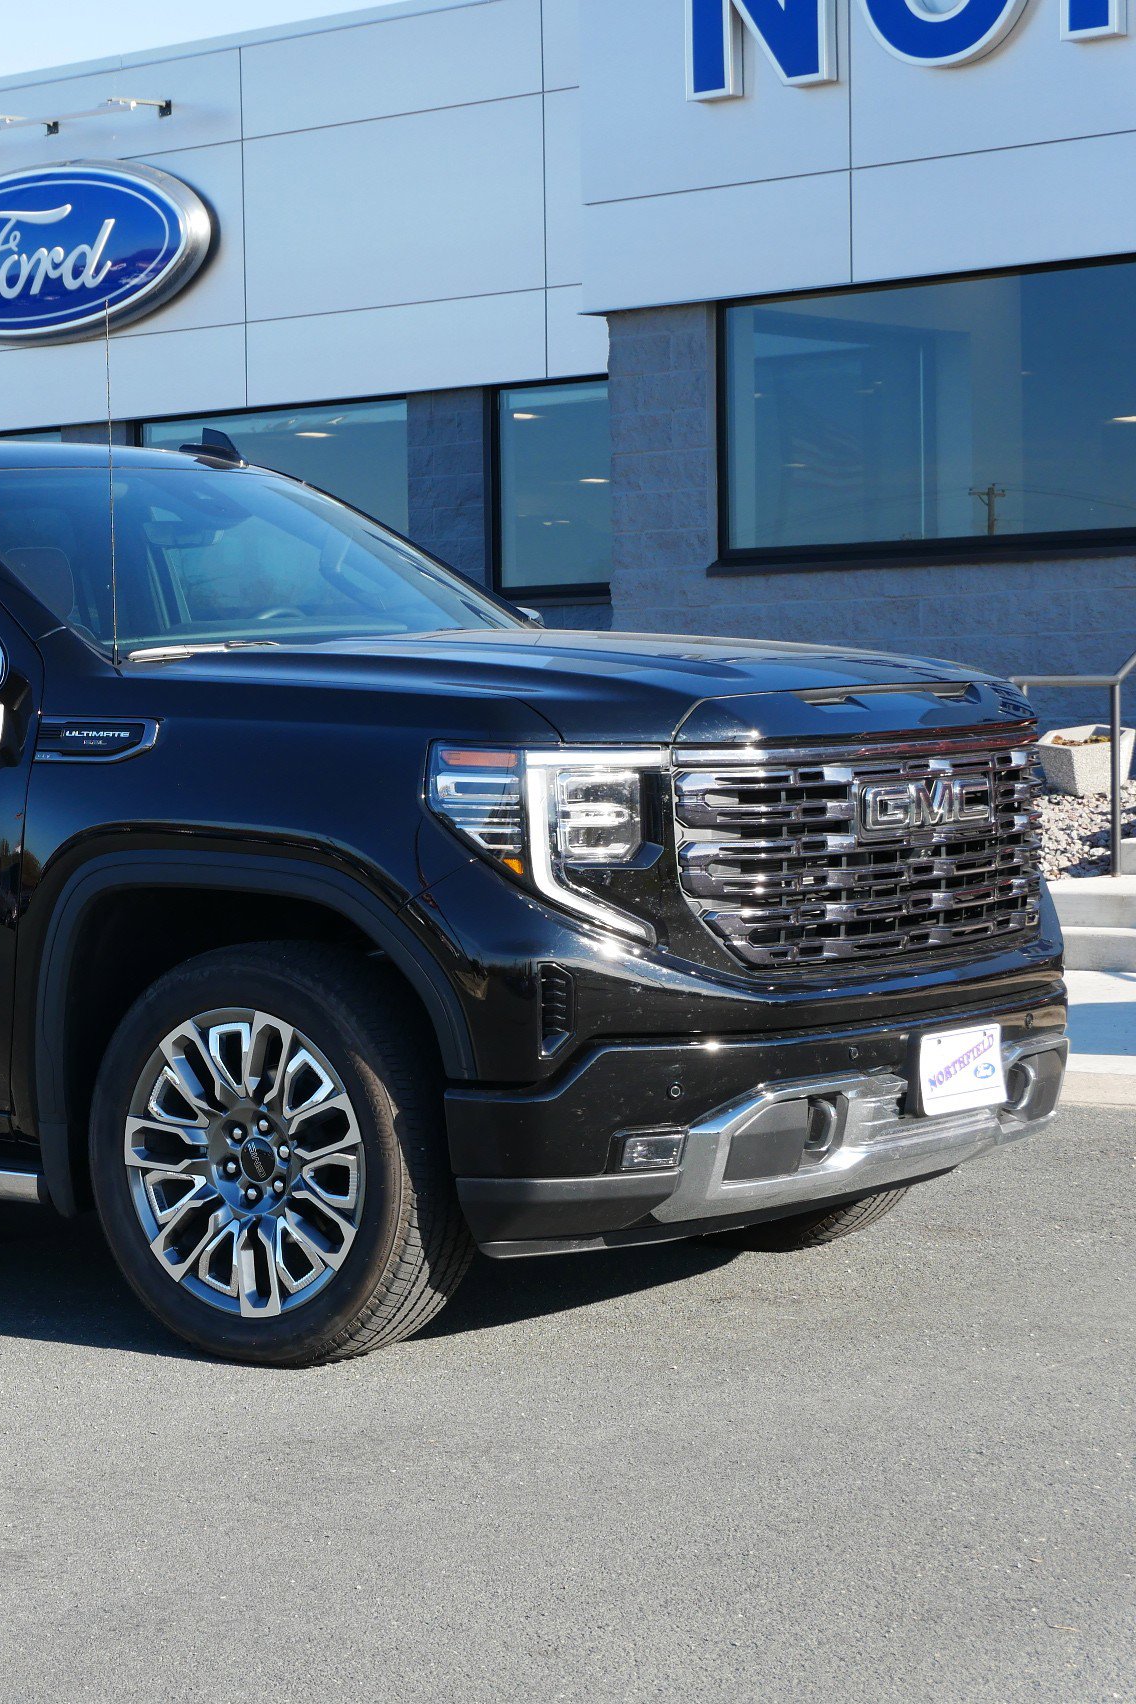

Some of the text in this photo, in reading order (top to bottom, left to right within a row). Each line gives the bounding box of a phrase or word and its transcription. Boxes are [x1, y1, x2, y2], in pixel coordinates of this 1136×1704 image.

[65, 730, 131, 739] ULTIMATE
[862, 778, 989, 831] GMC
[927, 1033, 995, 1089] NORTHFIELD
